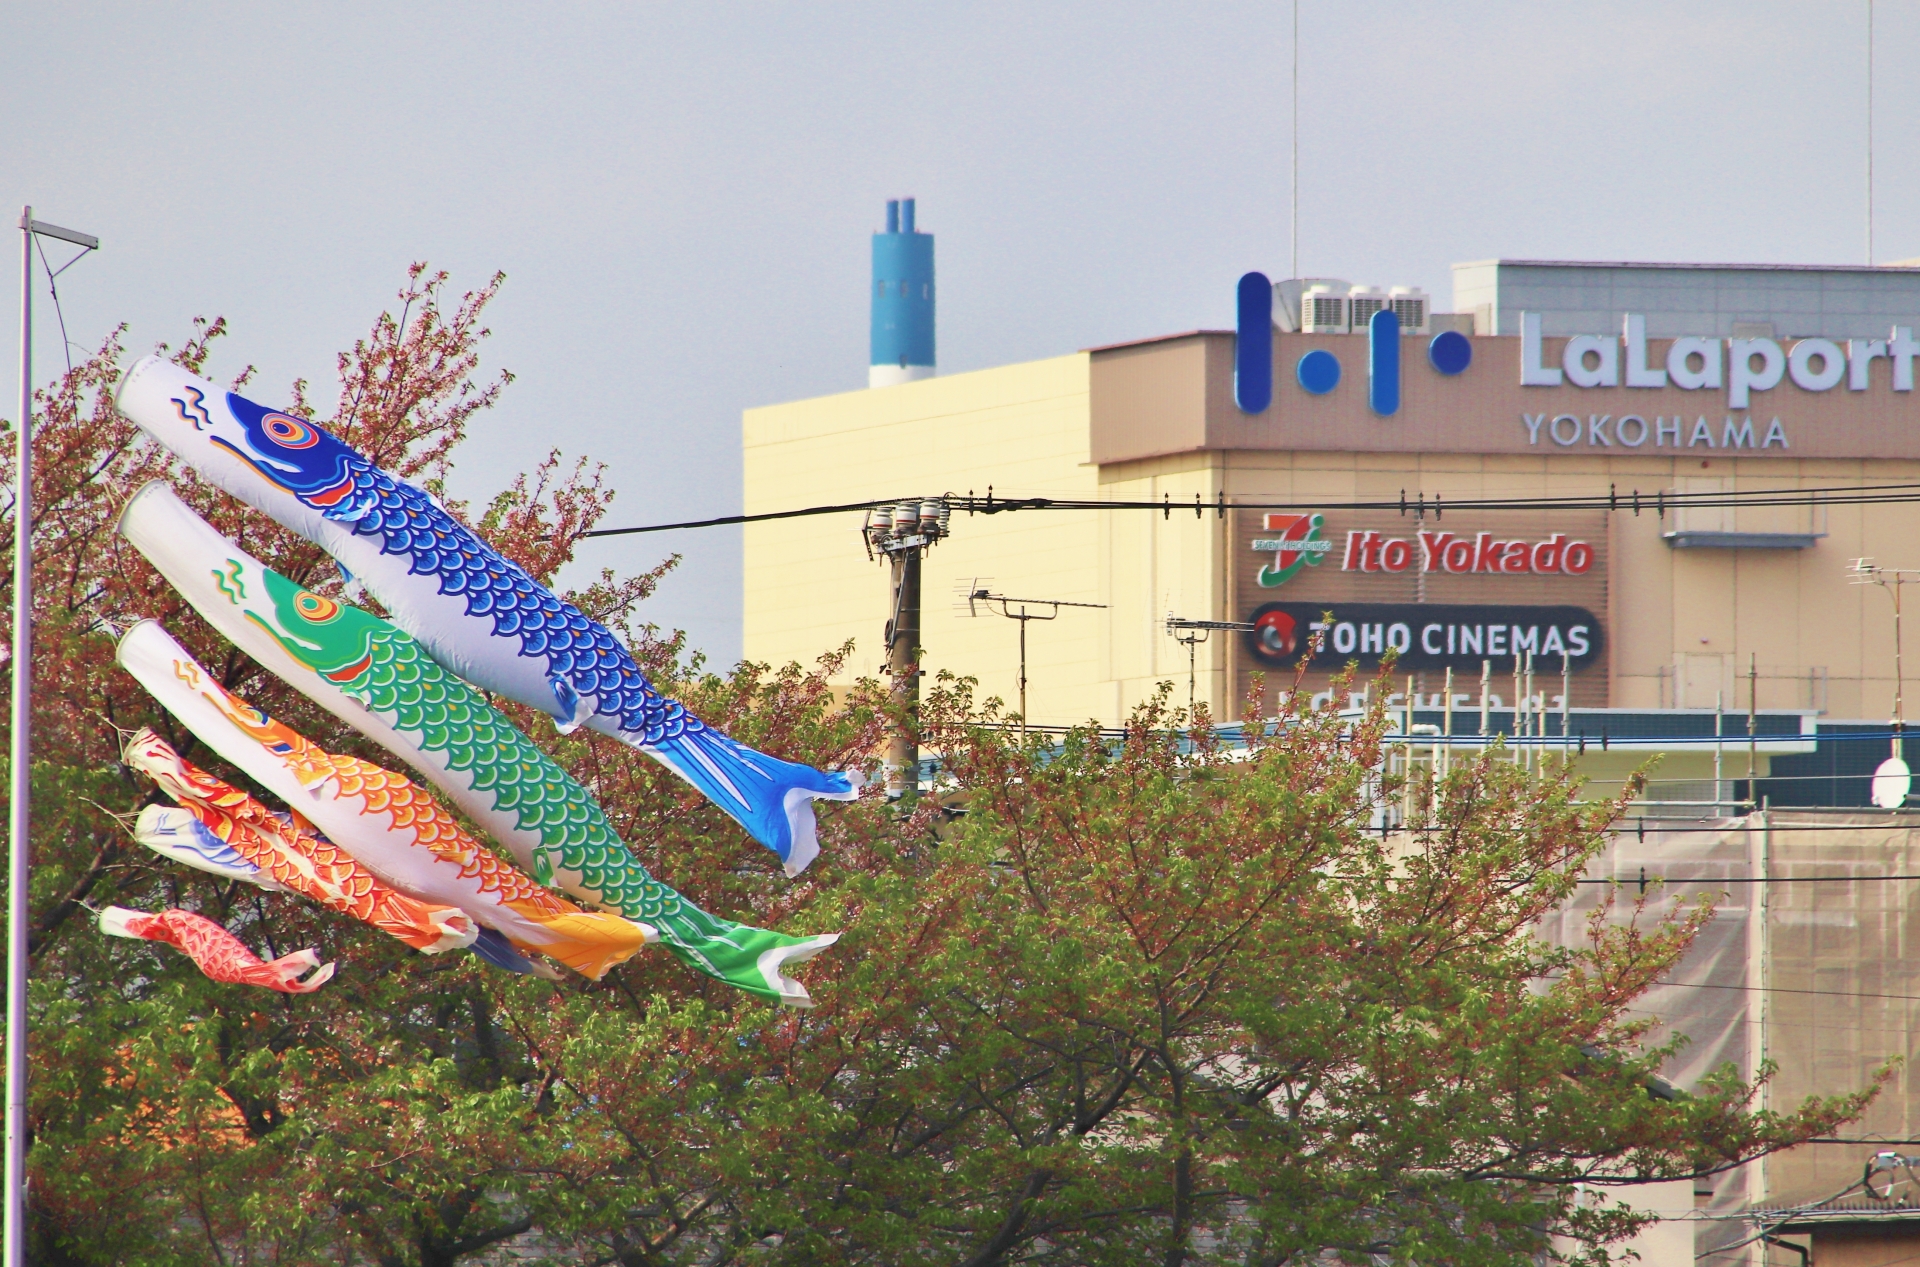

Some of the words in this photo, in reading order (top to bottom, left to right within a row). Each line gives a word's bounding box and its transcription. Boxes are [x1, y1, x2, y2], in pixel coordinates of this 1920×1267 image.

[1519, 310, 1920, 409] LaLaport
[1522, 414, 1790, 449] YOKOHAMA
[1341, 530, 1412, 573] Ito
[1417, 530, 1594, 575] Yokado
[1309, 621, 1412, 654] TOHO
[1421, 623, 1590, 657] CINEMAS
